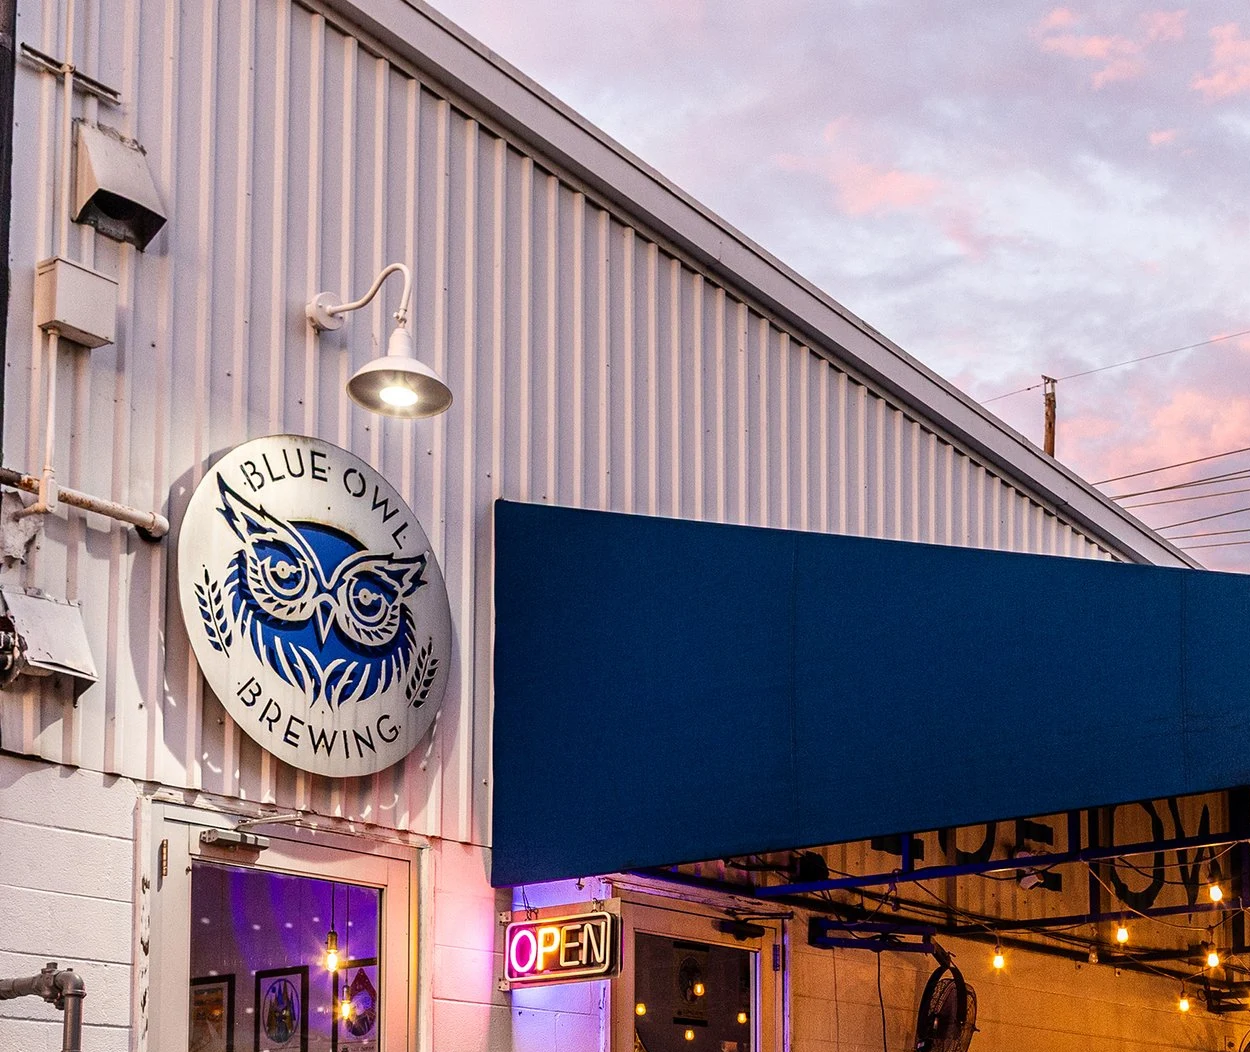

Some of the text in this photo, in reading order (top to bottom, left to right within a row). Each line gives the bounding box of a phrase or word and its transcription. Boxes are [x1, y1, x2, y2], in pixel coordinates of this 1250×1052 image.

[240, 448, 409, 549] BLUE OWL
[236, 677, 400, 759] BREWING
[510, 921, 606, 973] OPEN
